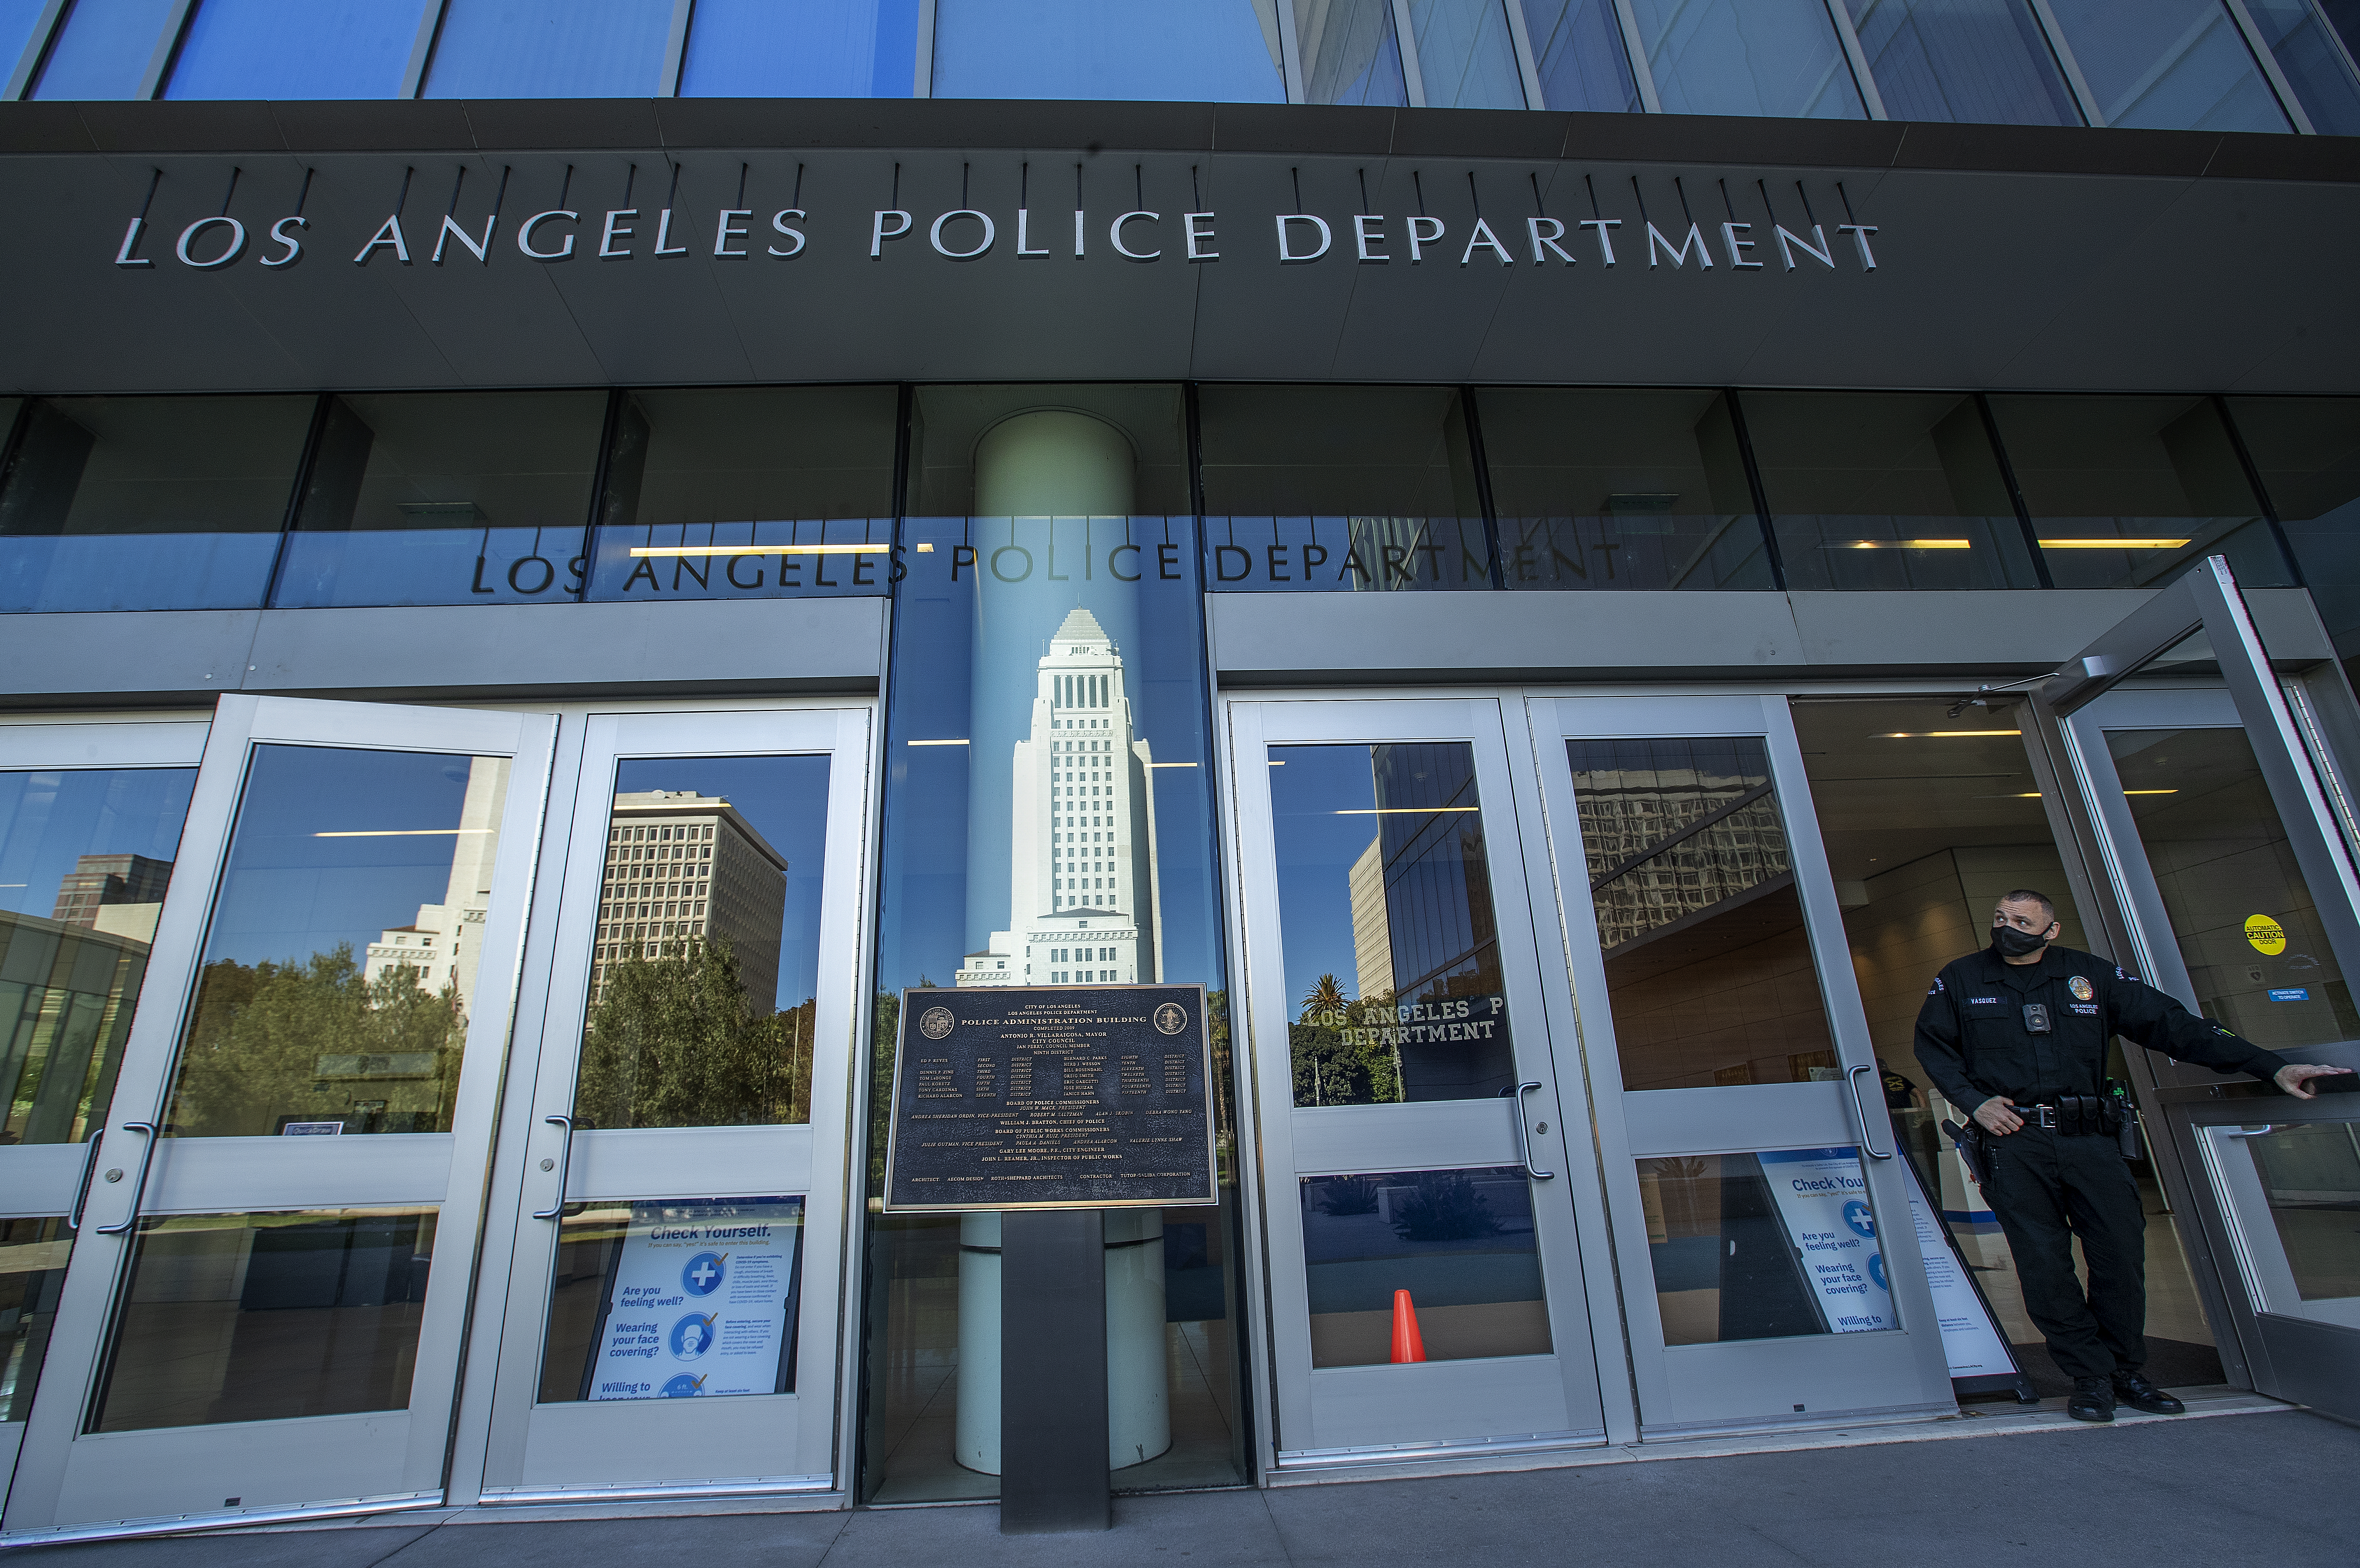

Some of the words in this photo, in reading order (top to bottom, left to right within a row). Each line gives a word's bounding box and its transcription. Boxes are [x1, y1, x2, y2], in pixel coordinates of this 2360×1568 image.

[115, 216, 308, 268] LOS
[353, 208, 808, 264] ANGELES
[870, 209, 1219, 262] POLICE
[1276, 215, 1878, 272] DEPARTMENT
[470, 554, 585, 594] LOS
[623, 546, 907, 592] ANGELES
[951, 544, 1181, 582] POLICE
[1217, 543, 1620, 582] DEPARTMENT
[1306, 1009, 1347, 1027] LOS
[1364, 1000, 1469, 1025] ANGELES
[1341, 1021, 1494, 1047] DEPARTMENT
[1792, 1177, 1837, 1191] Check
[651, 1226, 699, 1240] Check
[704, 1223, 771, 1239] Yourself.
[1818, 1232, 1835, 1241] you
[1806, 1241, 1838, 1251] feeling
[1837, 1239, 1860, 1248] well?
[1815, 1263, 1855, 1273] Wearing
[1820, 1276, 1841, 1286] your
[622, 1286, 640, 1295] Are
[643, 1287, 661, 1297] you
[1826, 1283, 1867, 1294] covering?
[620, 1297, 655, 1308] feeling
[657, 1297, 684, 1306] well?
[1837, 1315, 1872, 1326] Willing
[616, 1322, 658, 1334] Wearing
[612, 1336, 636, 1347] your
[638, 1335, 659, 1345] face
[609, 1346, 659, 1358] covering?
[602, 1382, 638, 1394] Willing
[640, 1382, 650, 1391] to
